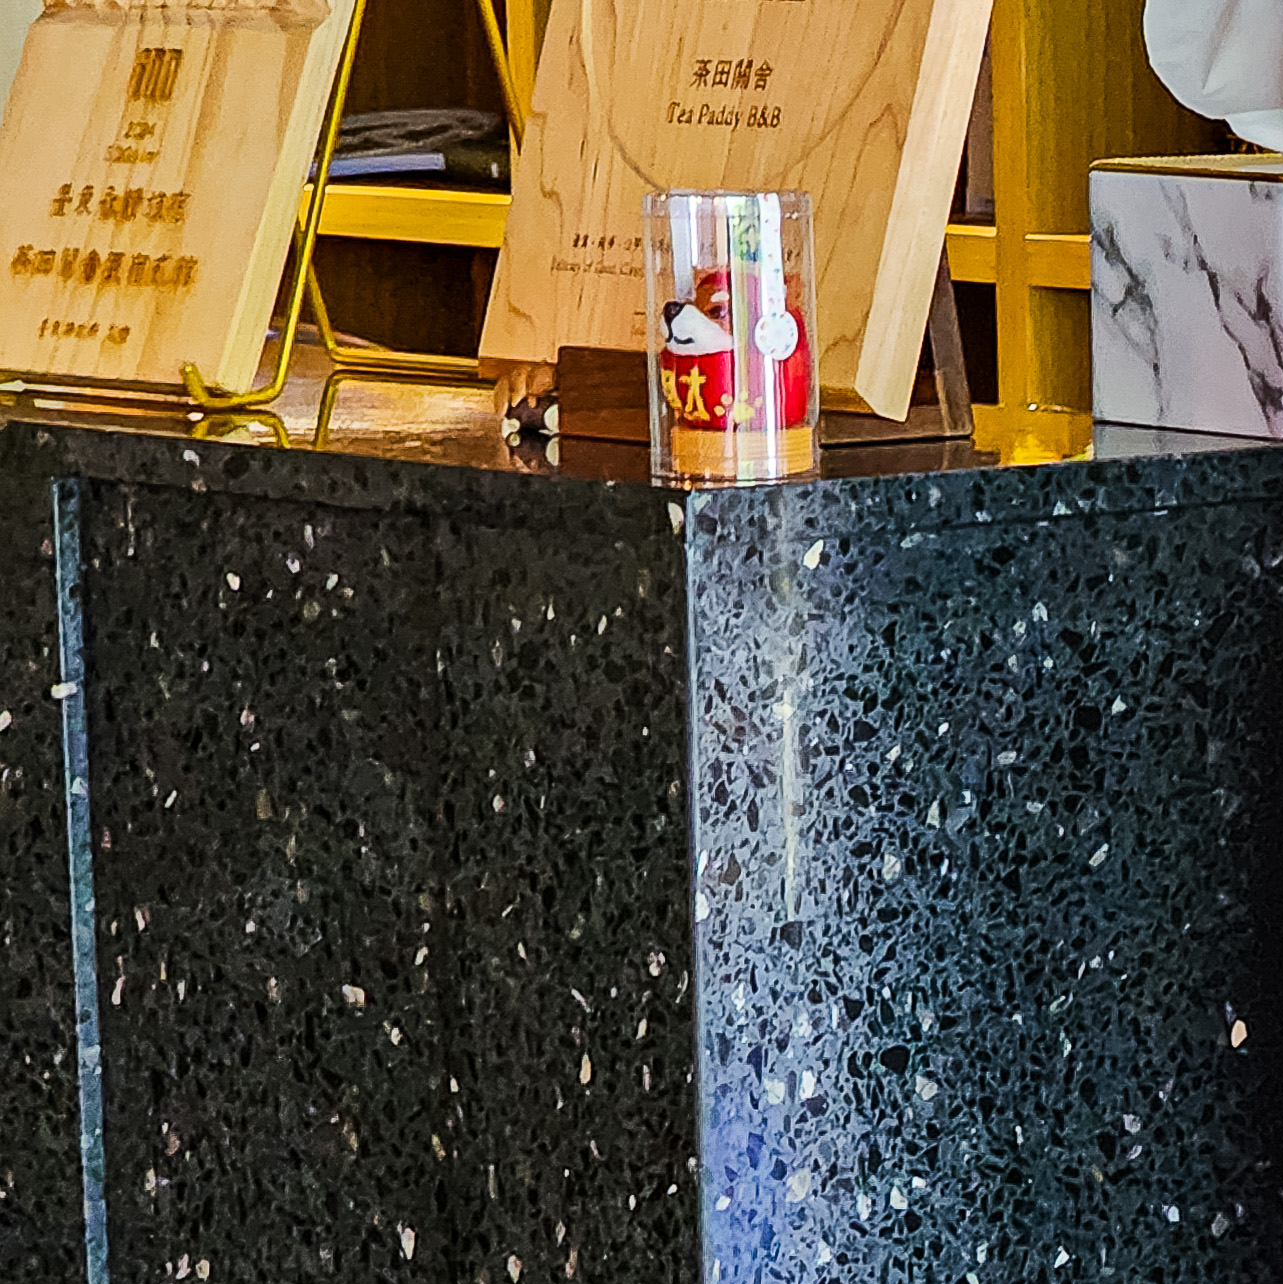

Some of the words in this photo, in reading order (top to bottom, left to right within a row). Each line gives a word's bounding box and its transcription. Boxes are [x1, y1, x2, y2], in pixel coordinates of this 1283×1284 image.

[667, 101, 694, 124] Tea
[698, 103, 740, 132] Paddy
[747, 105, 781, 128] B&B
